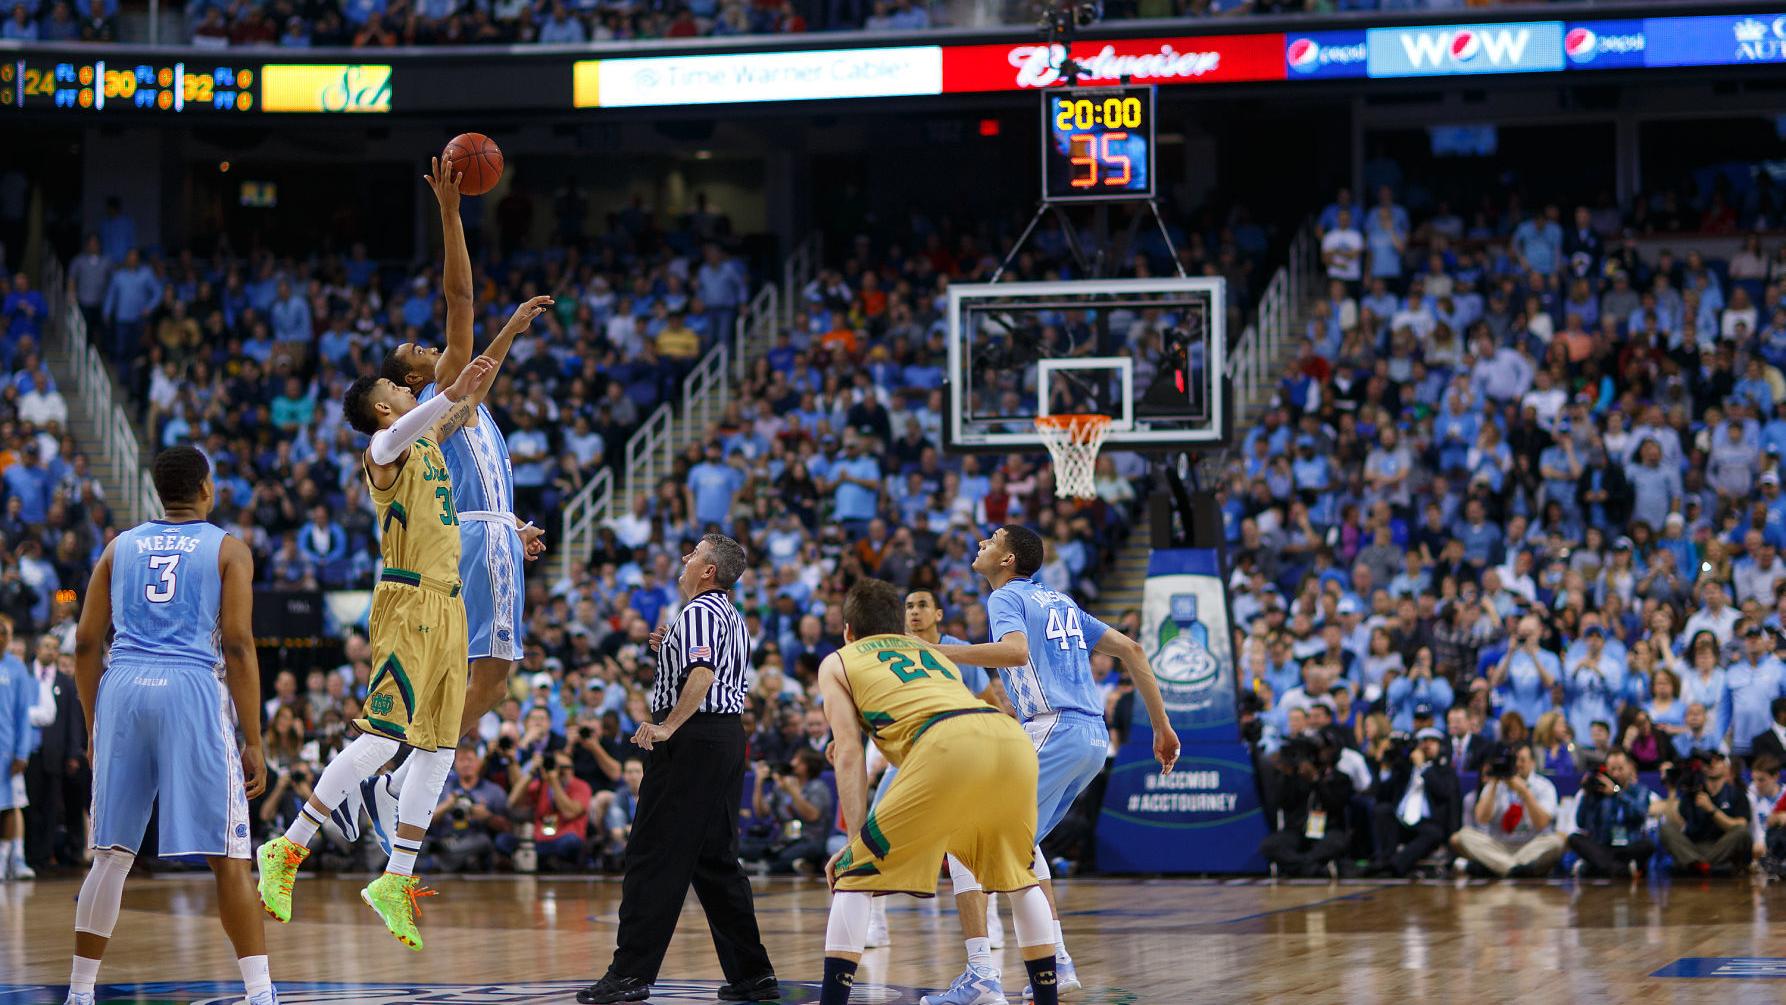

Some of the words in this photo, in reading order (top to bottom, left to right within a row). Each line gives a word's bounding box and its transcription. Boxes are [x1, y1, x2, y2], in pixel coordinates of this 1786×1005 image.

[1401, 29, 1530, 69] WOW
[25, 69, 55, 96] 24
[104, 70, 137, 98] 30
[1056, 97, 1141, 130] 20:00
[1070, 132, 1131, 187] 35
[136, 535, 200, 553] MEEKS
[145, 554, 182, 603] 3
[1045, 607, 1087, 650] 44
[877, 649, 957, 683] 24
[1127, 794, 1237, 812] #ACCTOURNEY
